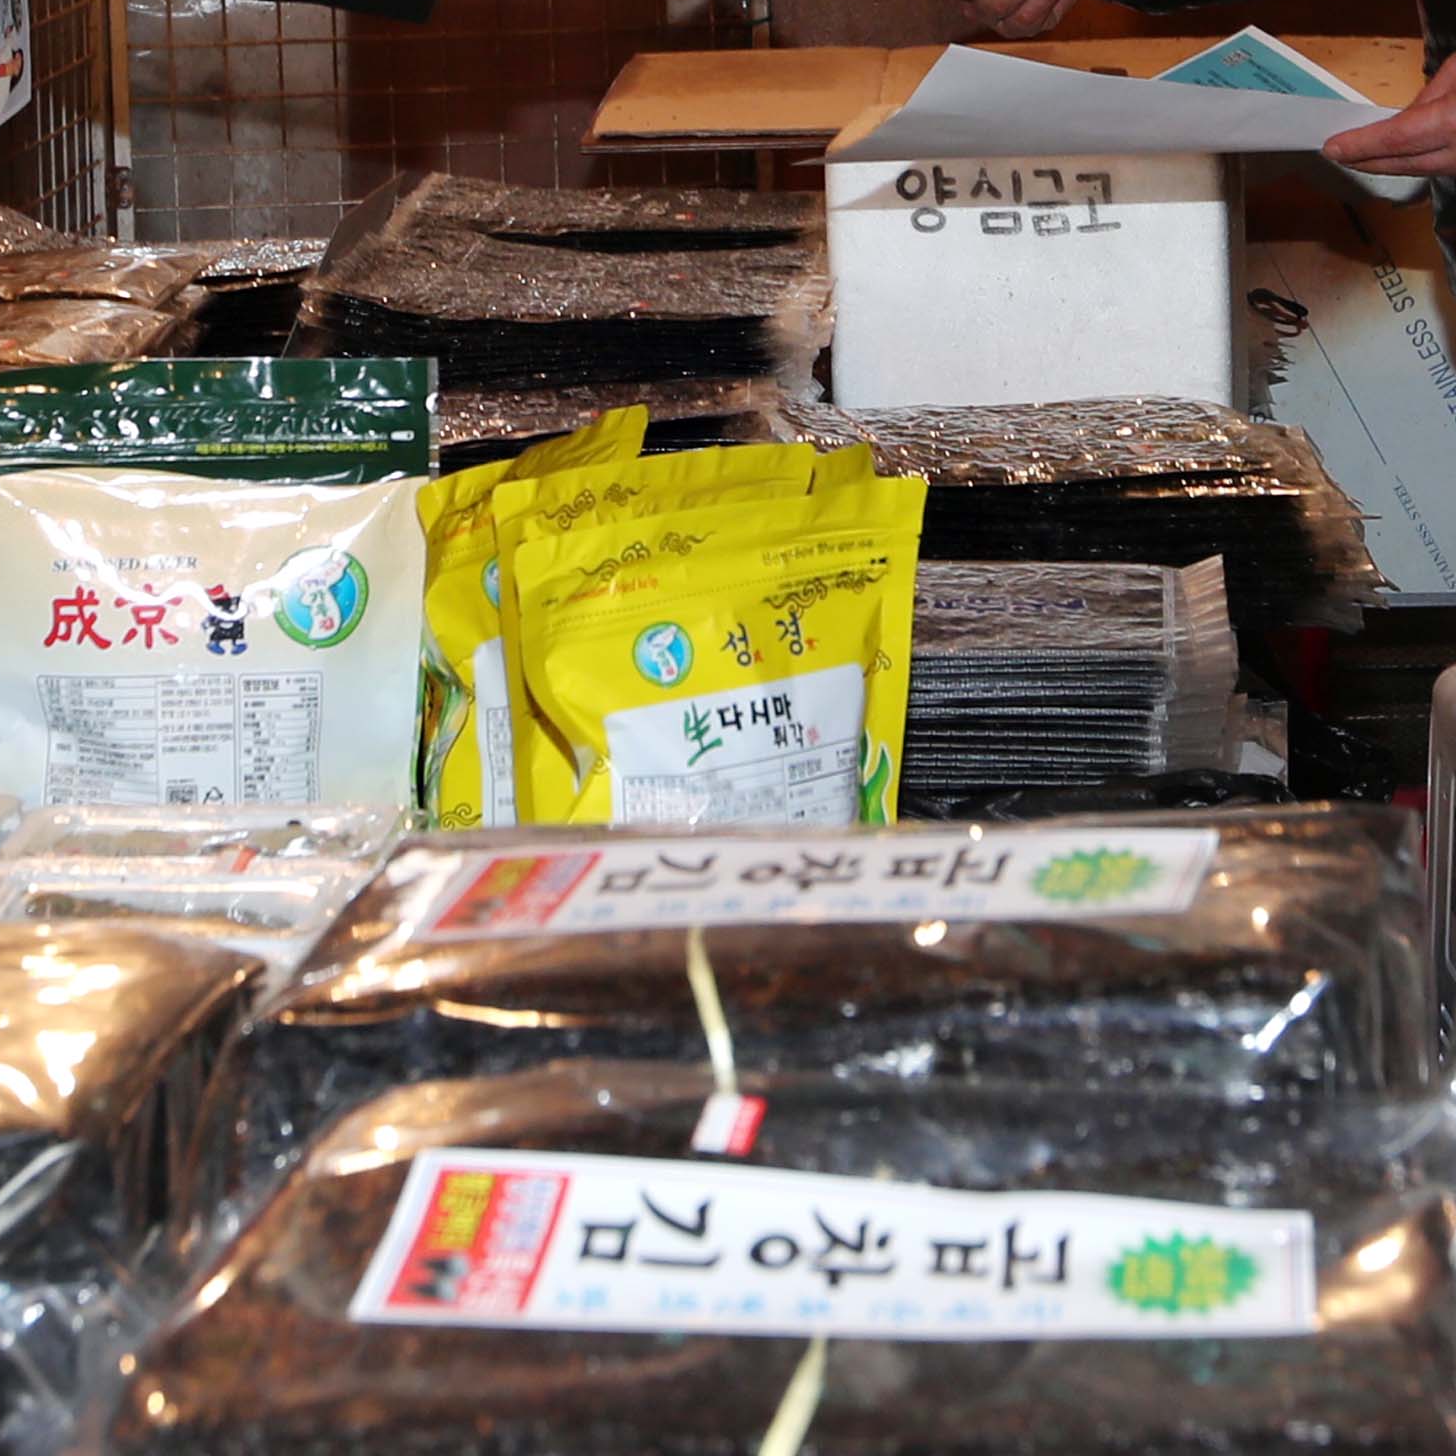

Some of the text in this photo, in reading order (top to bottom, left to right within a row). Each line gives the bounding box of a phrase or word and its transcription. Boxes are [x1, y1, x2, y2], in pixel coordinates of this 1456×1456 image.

[896, 165, 1121, 236] 양심금고
[43, 583, 183, 650] 成京
[578, 1189, 1071, 1292] 곱창김
